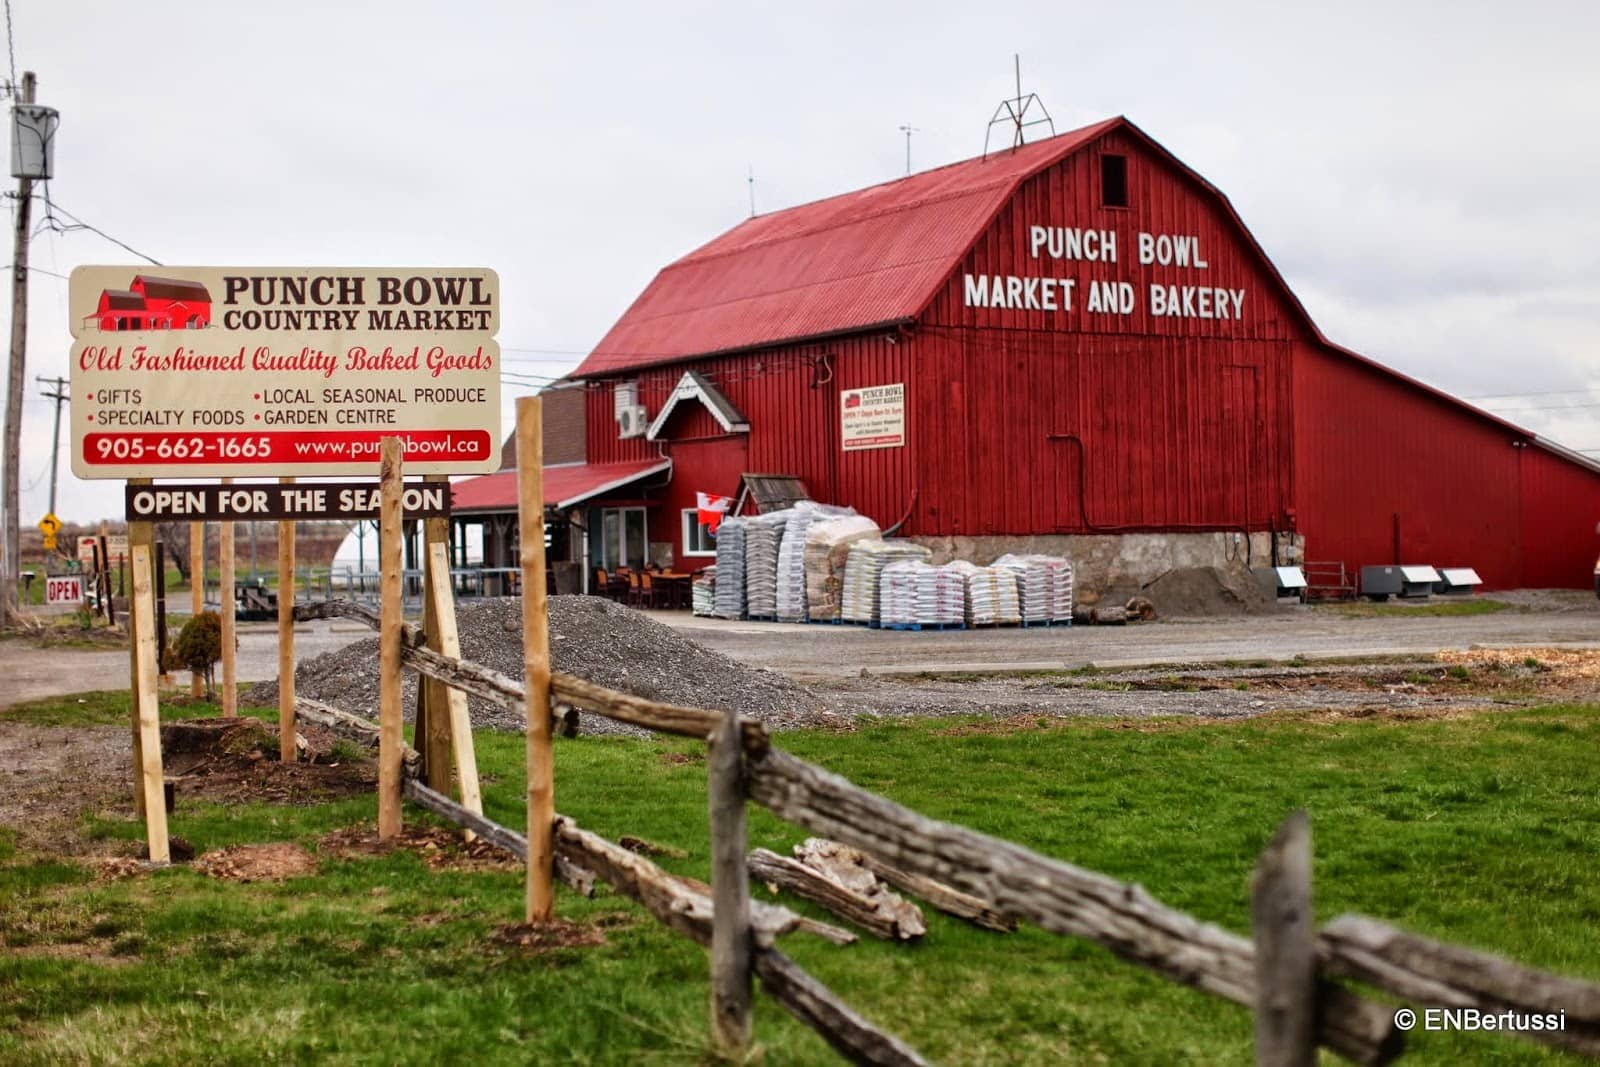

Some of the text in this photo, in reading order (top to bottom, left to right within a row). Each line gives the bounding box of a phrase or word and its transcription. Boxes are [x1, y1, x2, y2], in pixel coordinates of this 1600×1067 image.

[1030, 225, 1208, 269] PUNCH BOWL
[223, 276, 492, 306] PUNCH BOWL
[964, 273, 1245, 320] MARKET AND BAKERY
[224, 309, 492, 331] COUNTRY MARKET
[79, 346, 493, 378] Old Fashioned Quality Baked Goods
[97, 389, 142, 405] GIFTS
[263, 388, 486, 404] LOCAL SEASONAL PRODUCE
[97, 410, 245, 425] SPECIALTY FOODS
[264, 409, 396, 425] GARDEN CENTRE
[97, 436, 271, 459] 905-662-1665
[294, 434, 479, 459] www.punhbowl.ca
[133, 488, 444, 515] OPEN FOR THE SEAON
[49, 581, 79, 600] OPEN
